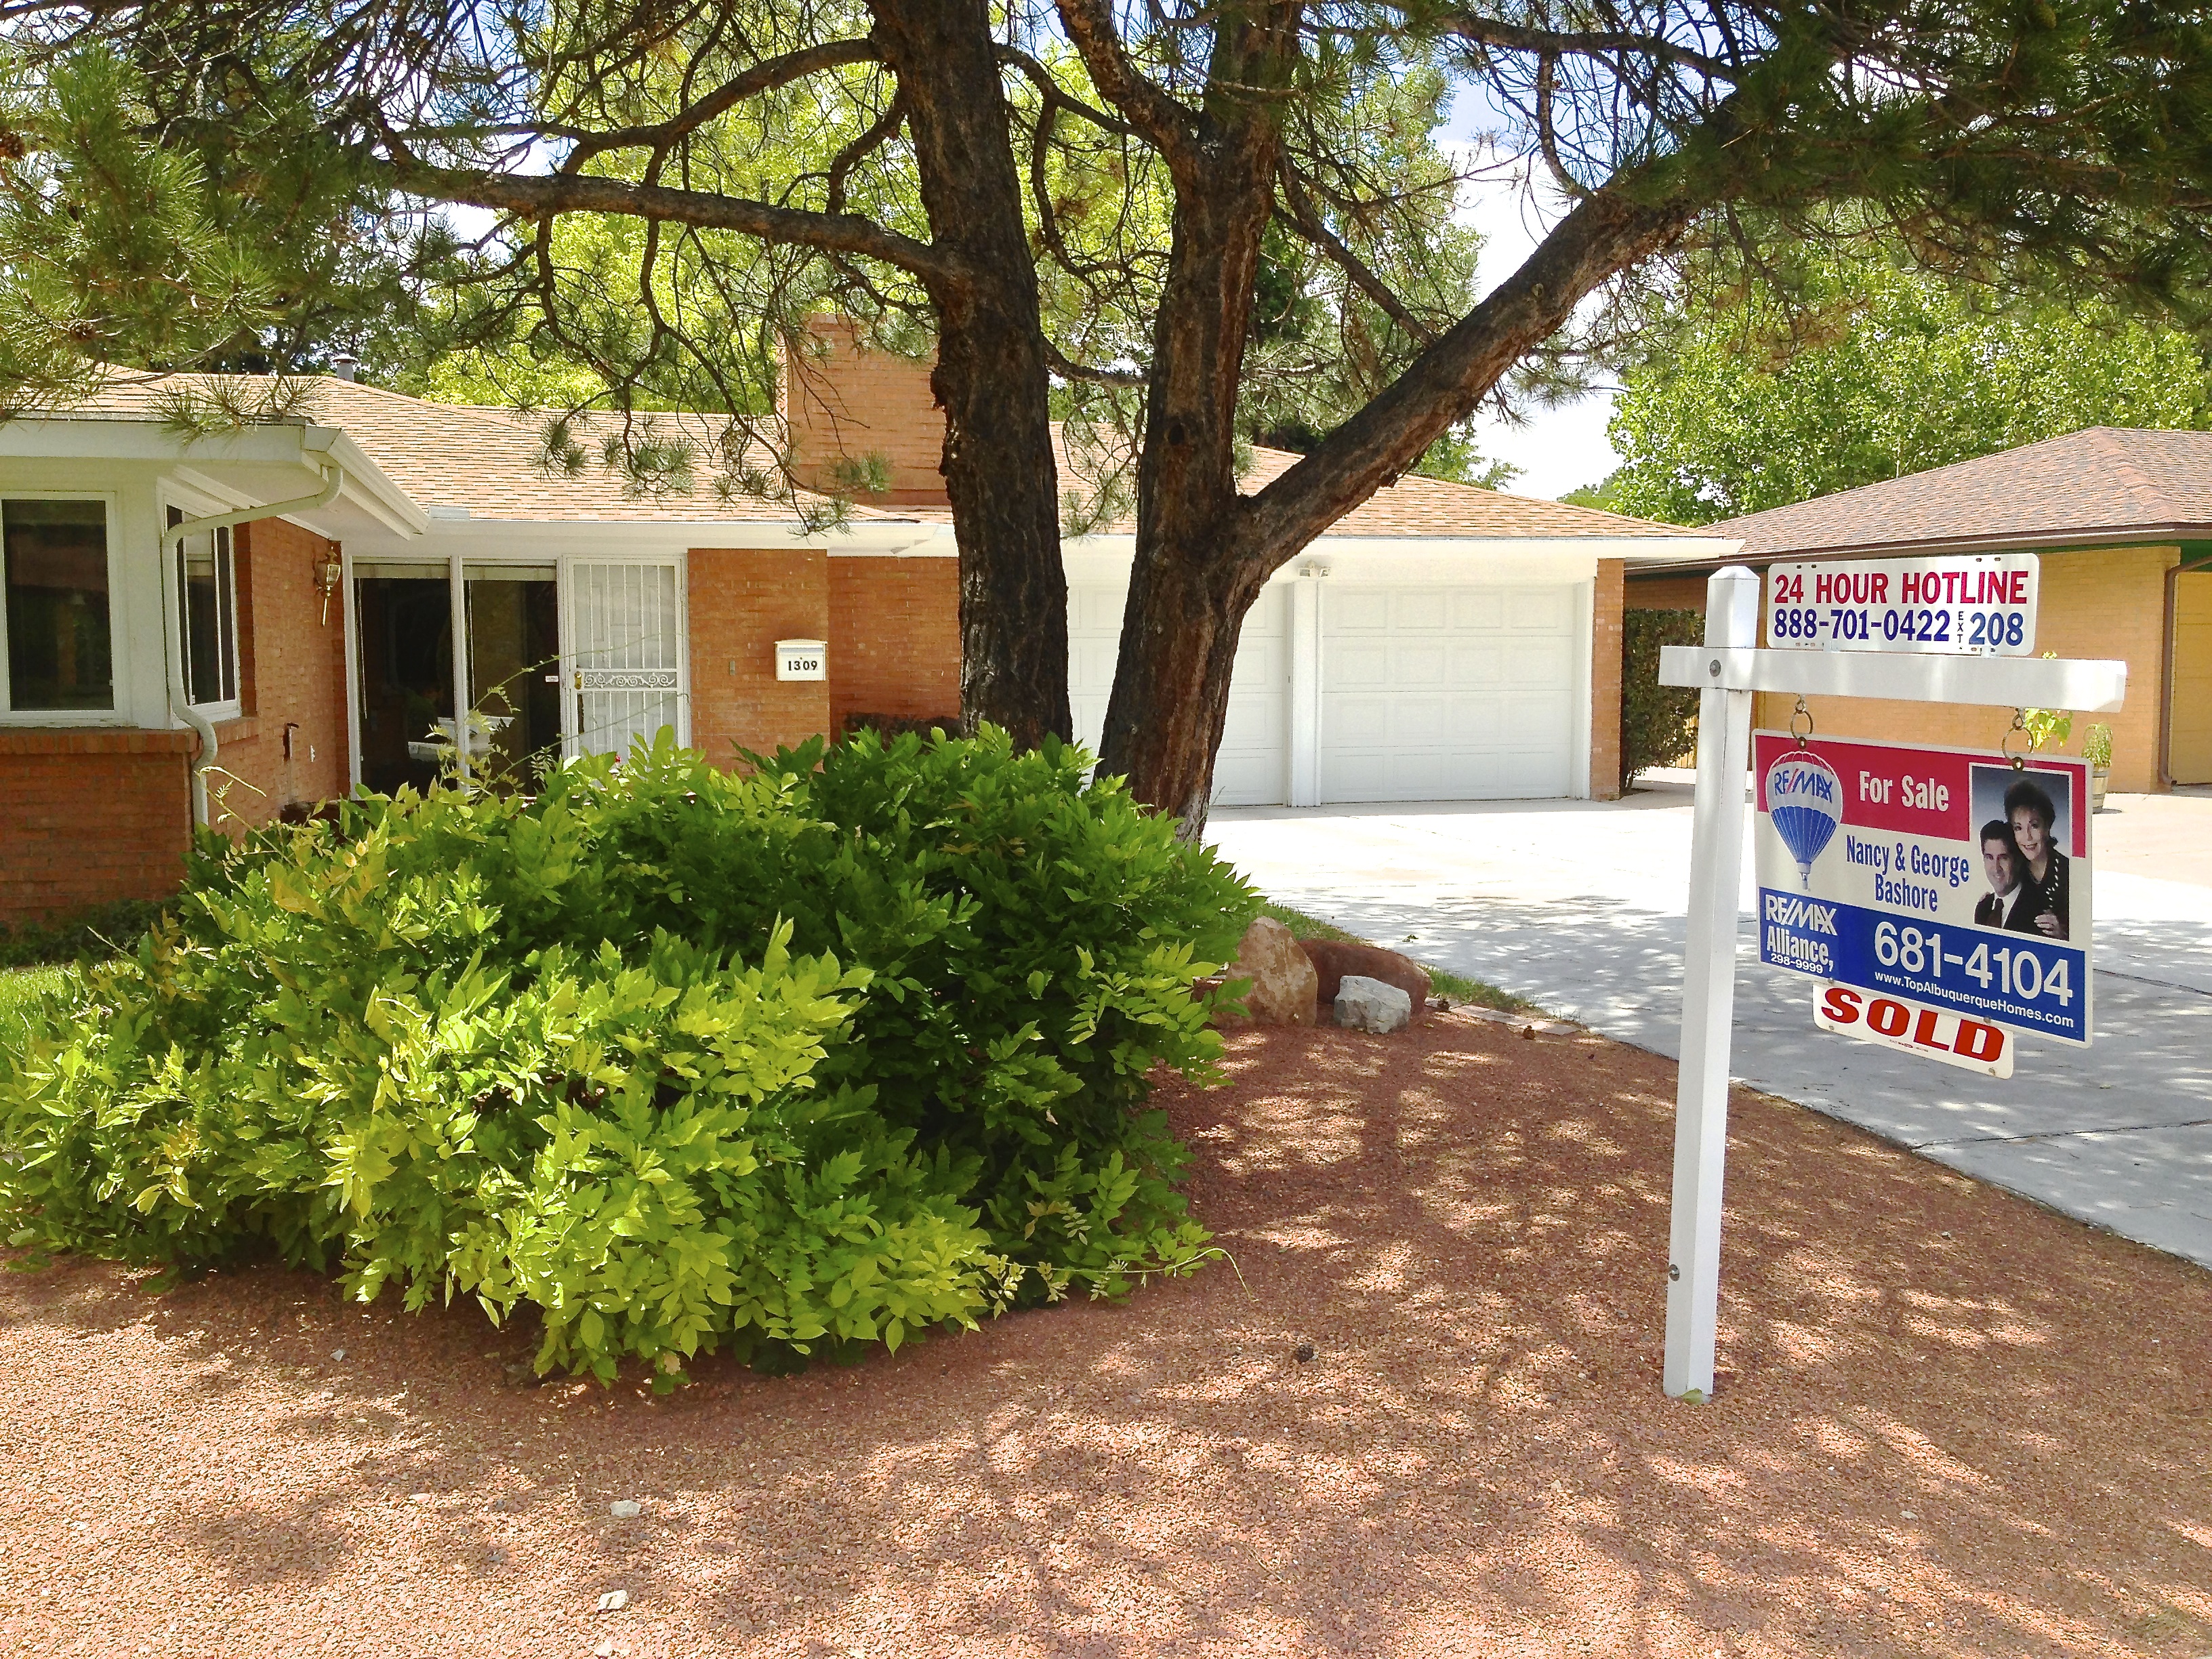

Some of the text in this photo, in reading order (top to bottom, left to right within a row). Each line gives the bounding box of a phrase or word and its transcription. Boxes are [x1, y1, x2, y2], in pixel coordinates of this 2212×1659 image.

[1774, 571, 2028, 604] 24 HOUR HOTLINE
[1774, 609, 1950, 642] 888-701-0422
[1969, 612, 2024, 646] 208
[788, 661, 817, 671] 1309
[1774, 768, 1832, 803] RE/MAX
[1859, 771, 1949, 811] For Sale
[1847, 835, 1969, 888] Nancy & George
[1875, 874, 1938, 912] Bashore
[1765, 895, 1838, 936] RE/MAX
[1771, 953, 1823, 974] 298-9999
[1875, 921, 2073, 1007] 681-4104
[1875, 970, 2074, 1028] www.TopAlbuquerqueHomes.com
[1821, 988, 2005, 1063] SOLD
